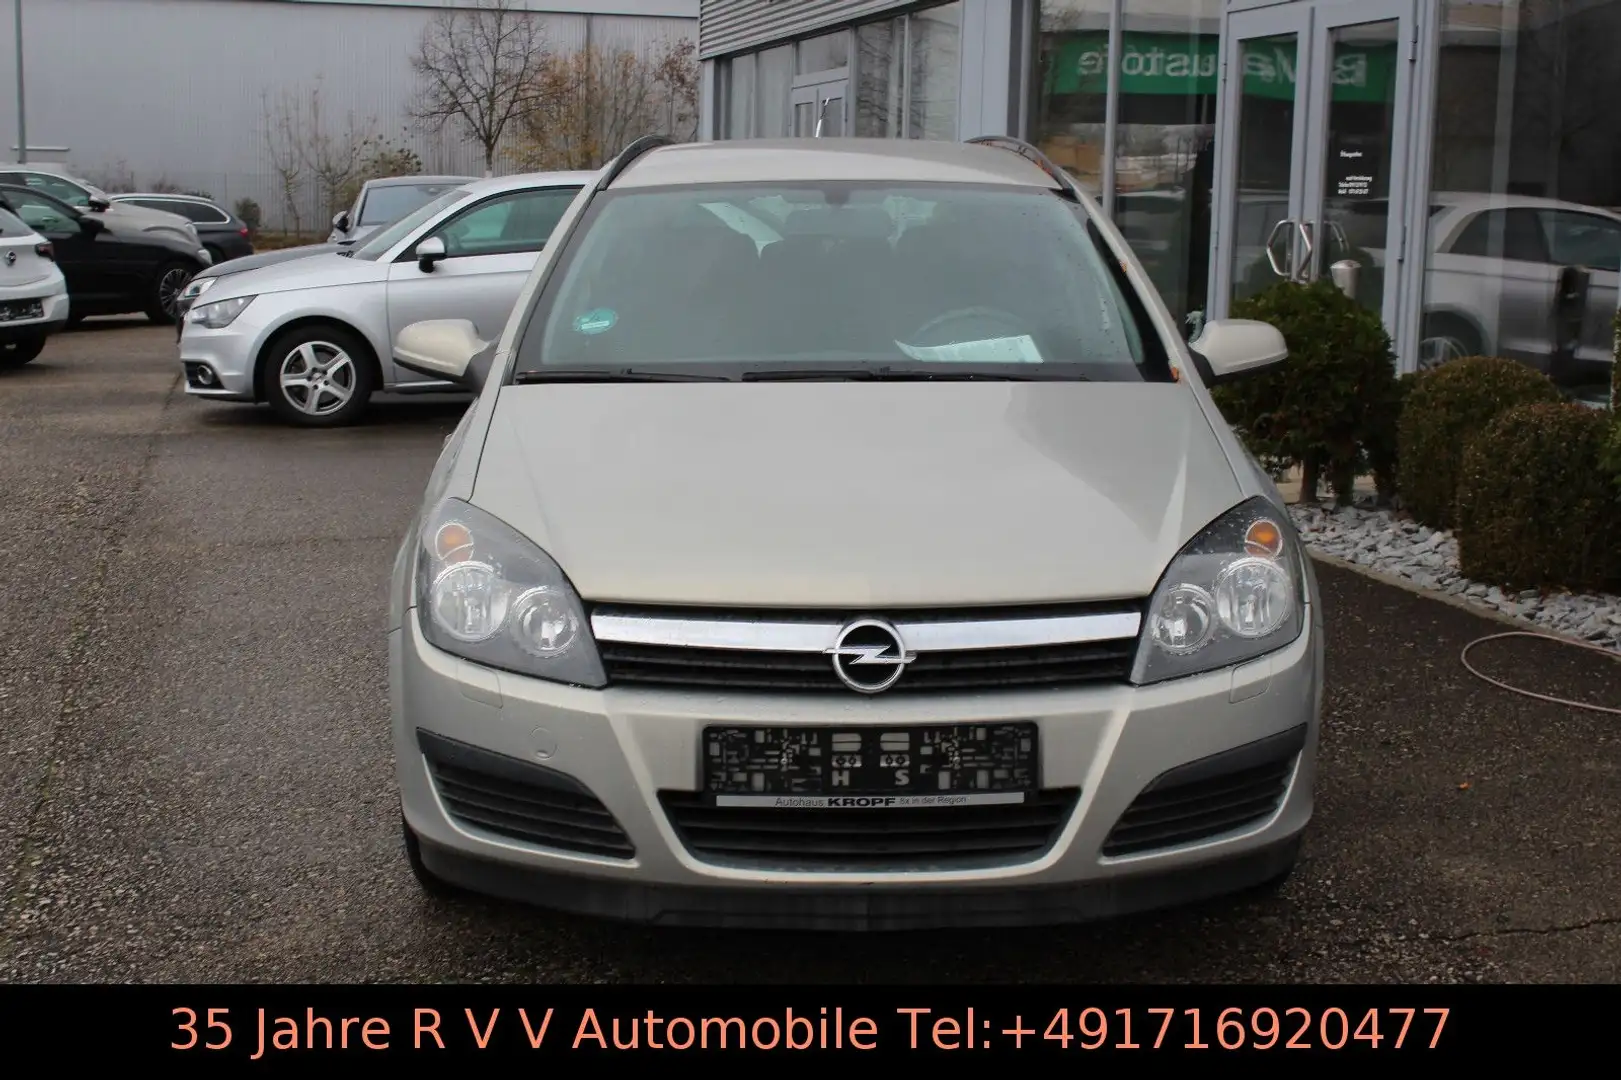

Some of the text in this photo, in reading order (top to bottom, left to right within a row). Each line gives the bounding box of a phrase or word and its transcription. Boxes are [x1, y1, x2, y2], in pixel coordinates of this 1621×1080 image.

[775, 797, 824, 807] Autohaus
[827, 797, 896, 807] KROPF
[921, 796, 935, 804] der
[937, 795, 967, 805] Region
